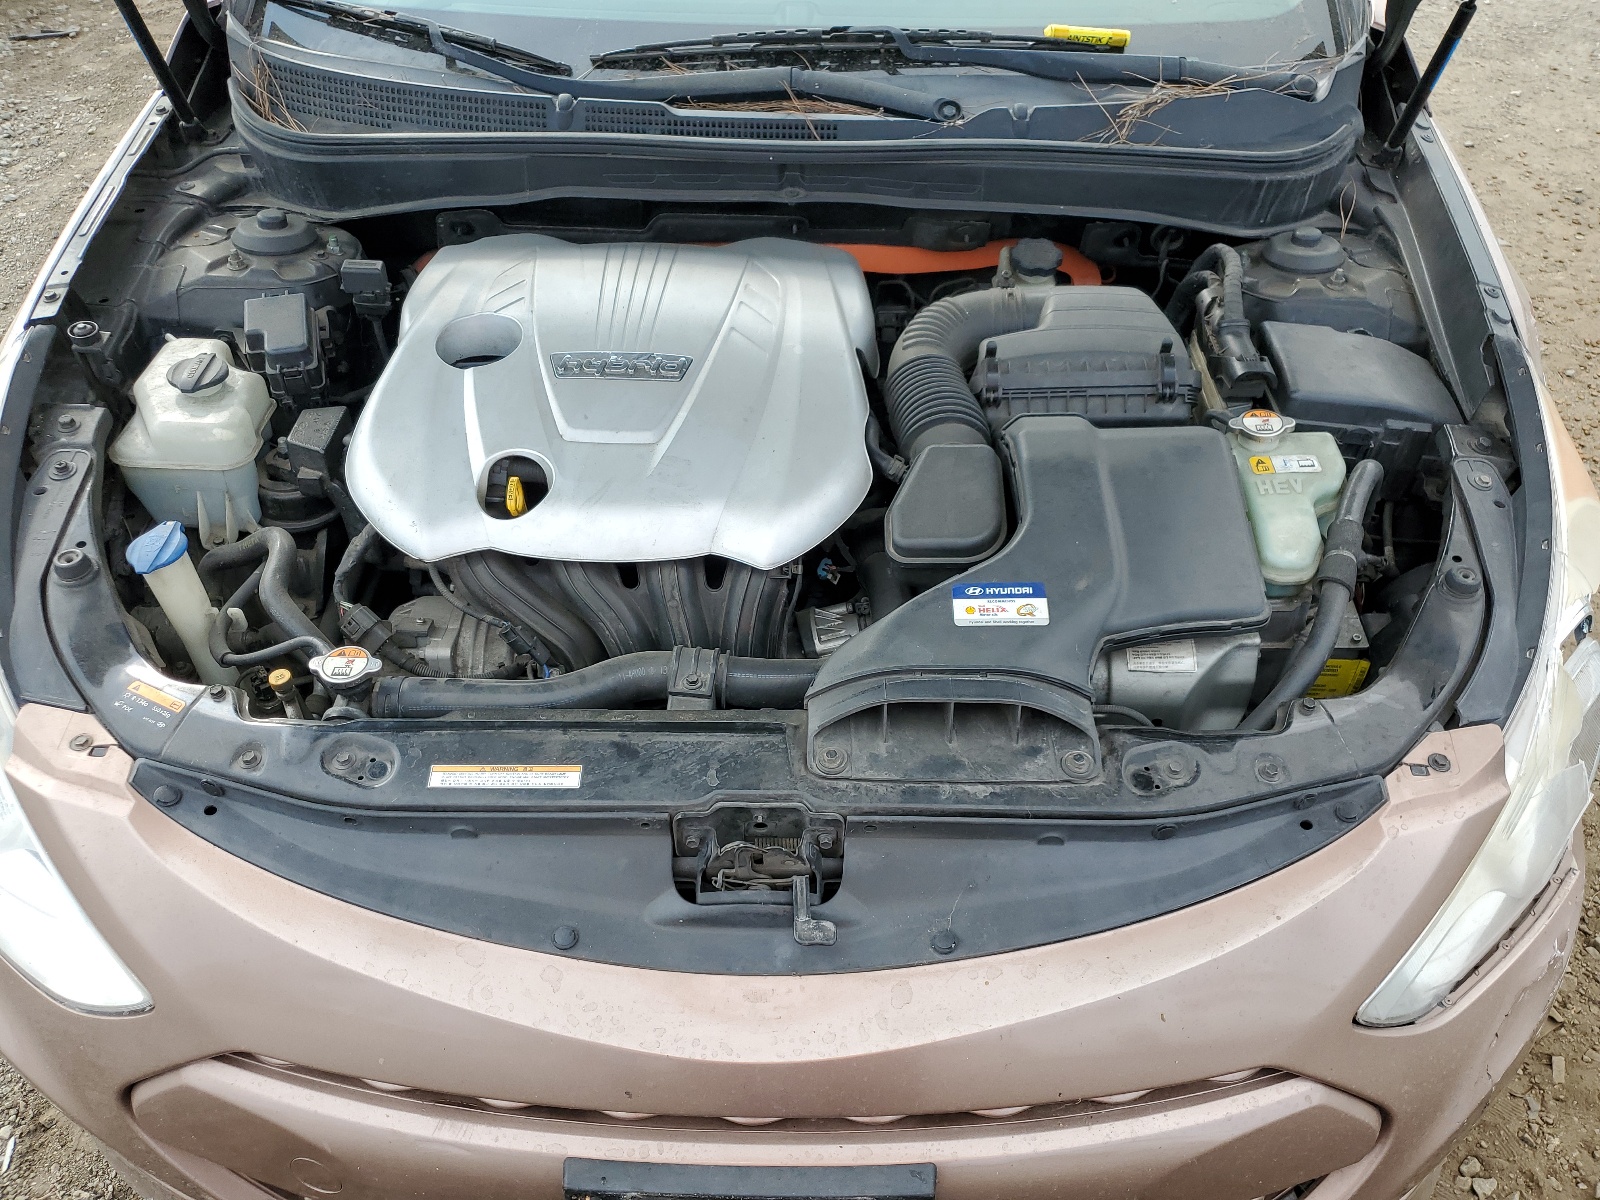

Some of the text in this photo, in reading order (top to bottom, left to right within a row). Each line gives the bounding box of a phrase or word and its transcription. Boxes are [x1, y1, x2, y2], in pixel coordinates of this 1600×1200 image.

[1067, 34, 1106, 44] AINTSTIK
[558, 355, 687, 376] hybrid
[1256, 478, 1303, 495] HEV
[986, 587, 1033, 595] HYUNDAI
